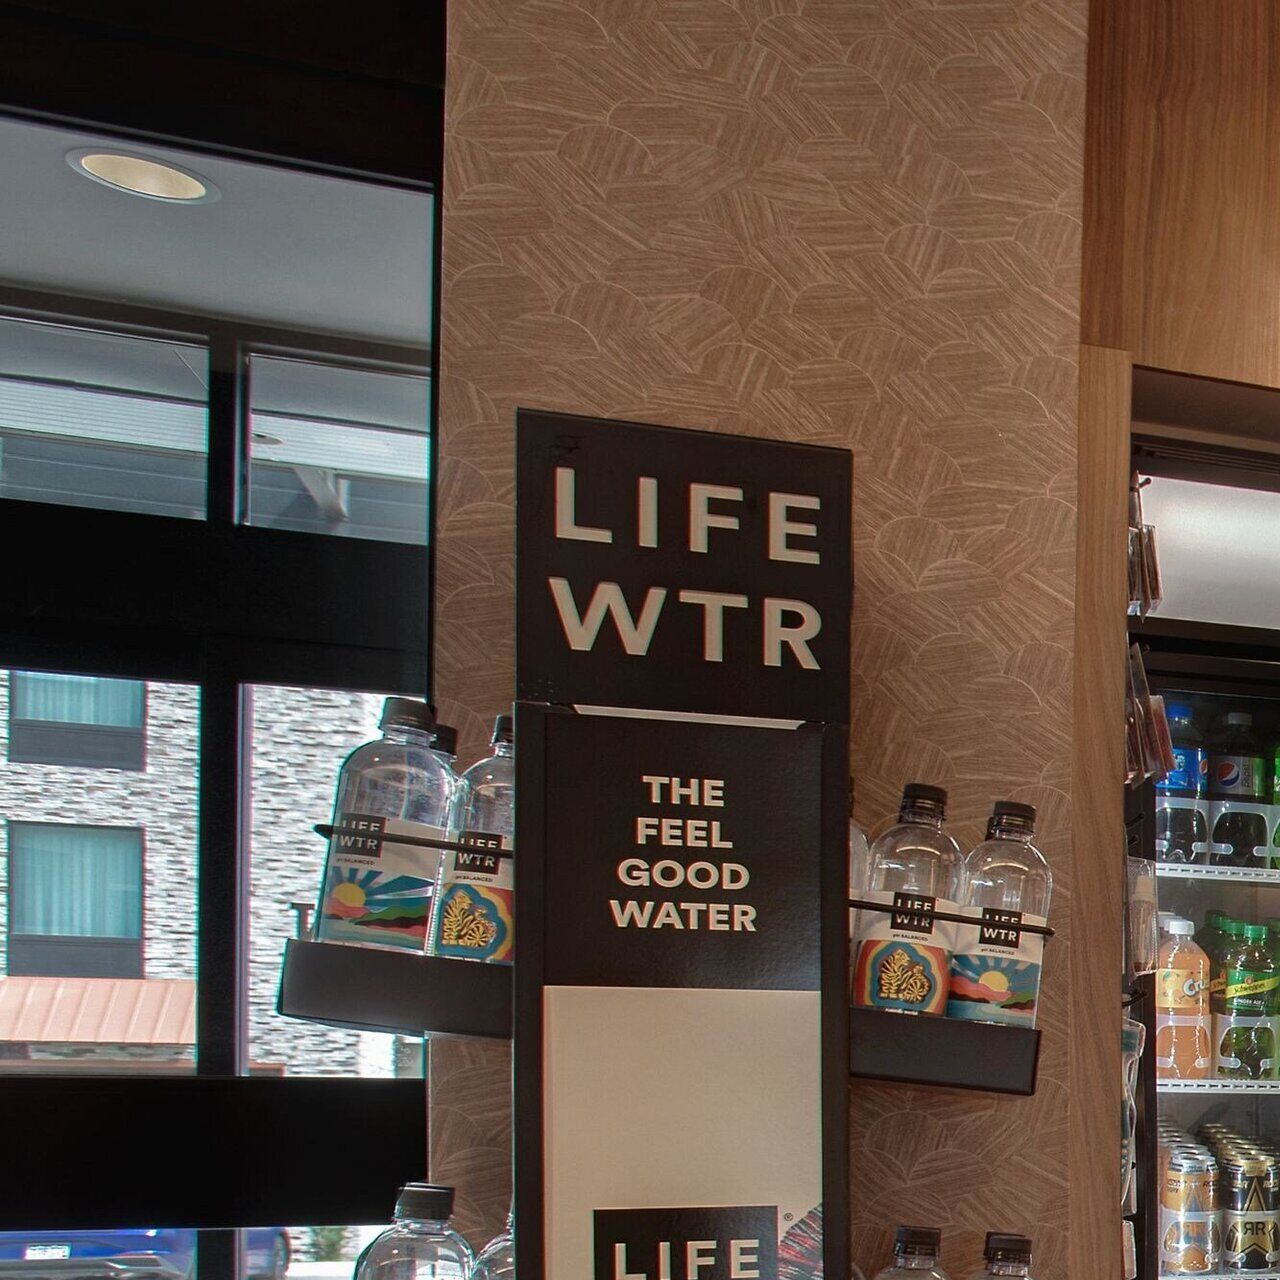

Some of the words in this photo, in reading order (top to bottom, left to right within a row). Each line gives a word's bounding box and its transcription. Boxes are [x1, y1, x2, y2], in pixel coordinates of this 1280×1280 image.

[553, 465, 822, 566] LIFE
[547, 576, 823, 671] WTR
[642, 774, 726, 808] THE
[339, 836, 379, 850] WTR
[635, 817, 734, 850] FEEL
[457, 852, 496, 868] WTR
[616, 858, 751, 892] GOOD
[608, 899, 758, 934] WATER
[983, 927, 1018, 942] WTR
